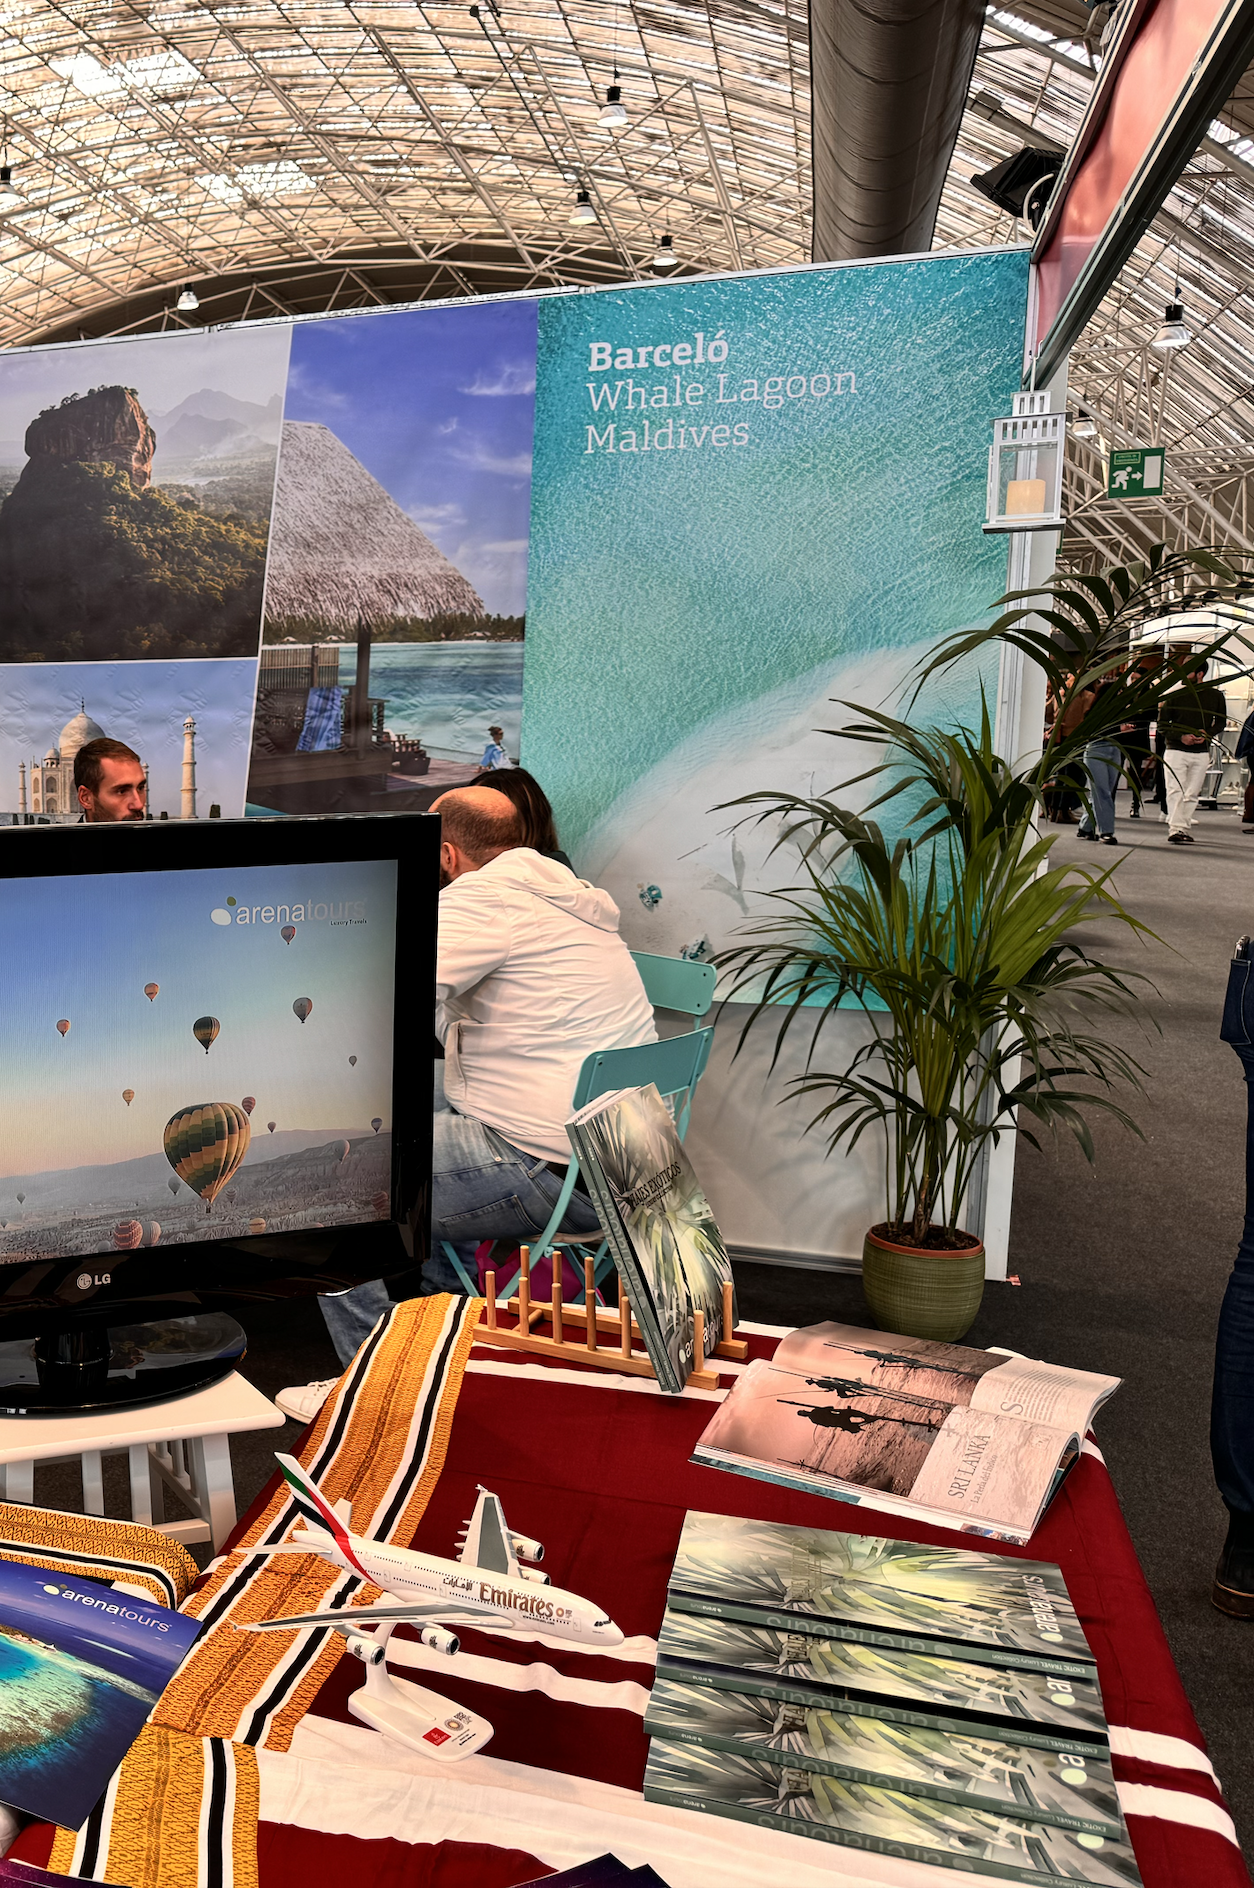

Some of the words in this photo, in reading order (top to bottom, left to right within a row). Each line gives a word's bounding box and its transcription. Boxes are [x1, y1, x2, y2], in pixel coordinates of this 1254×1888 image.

[587, 330, 729, 371] Barceló
[586, 375, 704, 411] Whale
[715, 369, 858, 409] Lagoon
[584, 418, 749, 454] Maldives
[236, 899, 366, 924] arenatours
[94, 1273, 111, 1286] LG
[957, 1434, 991, 1476] LANKA
[948, 1476, 971, 1499] SRI
[479, 1582, 553, 1618] Emirates
[61, 1590, 170, 1632] arenatours
[992, 1654, 1020, 1663] Collection
[1021, 1658, 1039, 1667] Luxury
[1040, 1661, 1063, 1671] TRAVEL
[1064, 1665, 1085, 1674] EXOTIC
[1050, 1741, 1074, 1751] TRAVEL
[1075, 1746, 1098, 1755] EXOTIC
[1056, 1816, 1081, 1827] TRAVEL
[1083, 1824, 1107, 1833] EXOTIC
